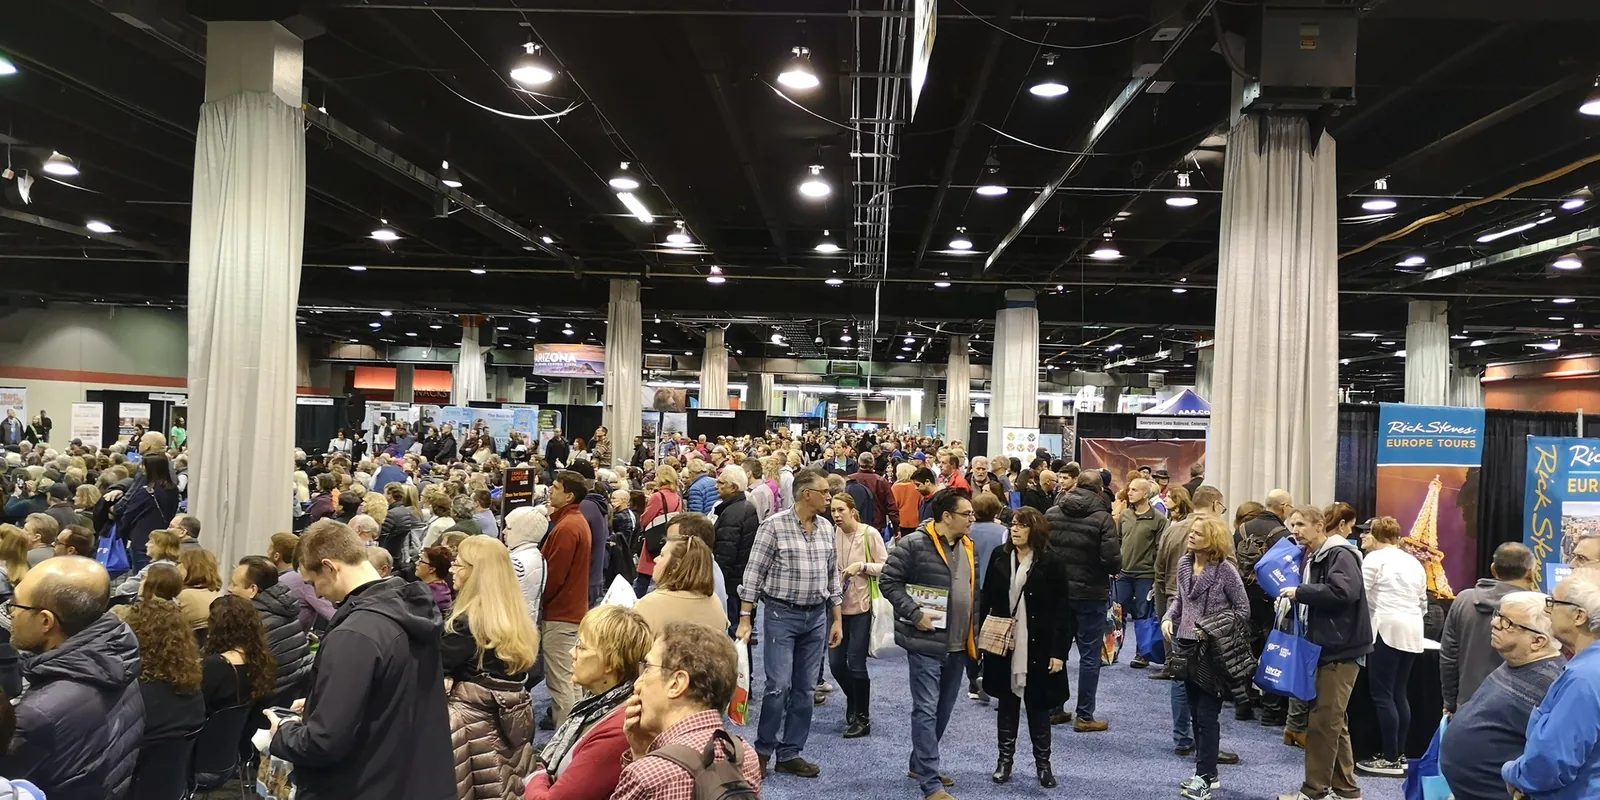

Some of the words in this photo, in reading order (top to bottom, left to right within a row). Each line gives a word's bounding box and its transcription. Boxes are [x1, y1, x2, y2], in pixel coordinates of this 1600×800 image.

[535, 352, 576, 363] ARIZONA
[414, 389, 448, 398] NACKS
[1387, 421, 1425, 434] Rick
[1425, 421, 1476, 434] Steves
[1386, 439, 1433, 448] EUROPE
[1437, 439, 1477, 449] TOURS
[1569, 444, 1600, 467] Ric
[1534, 444, 1558, 512] Rick
[1567, 478, 1600, 493] EUR
